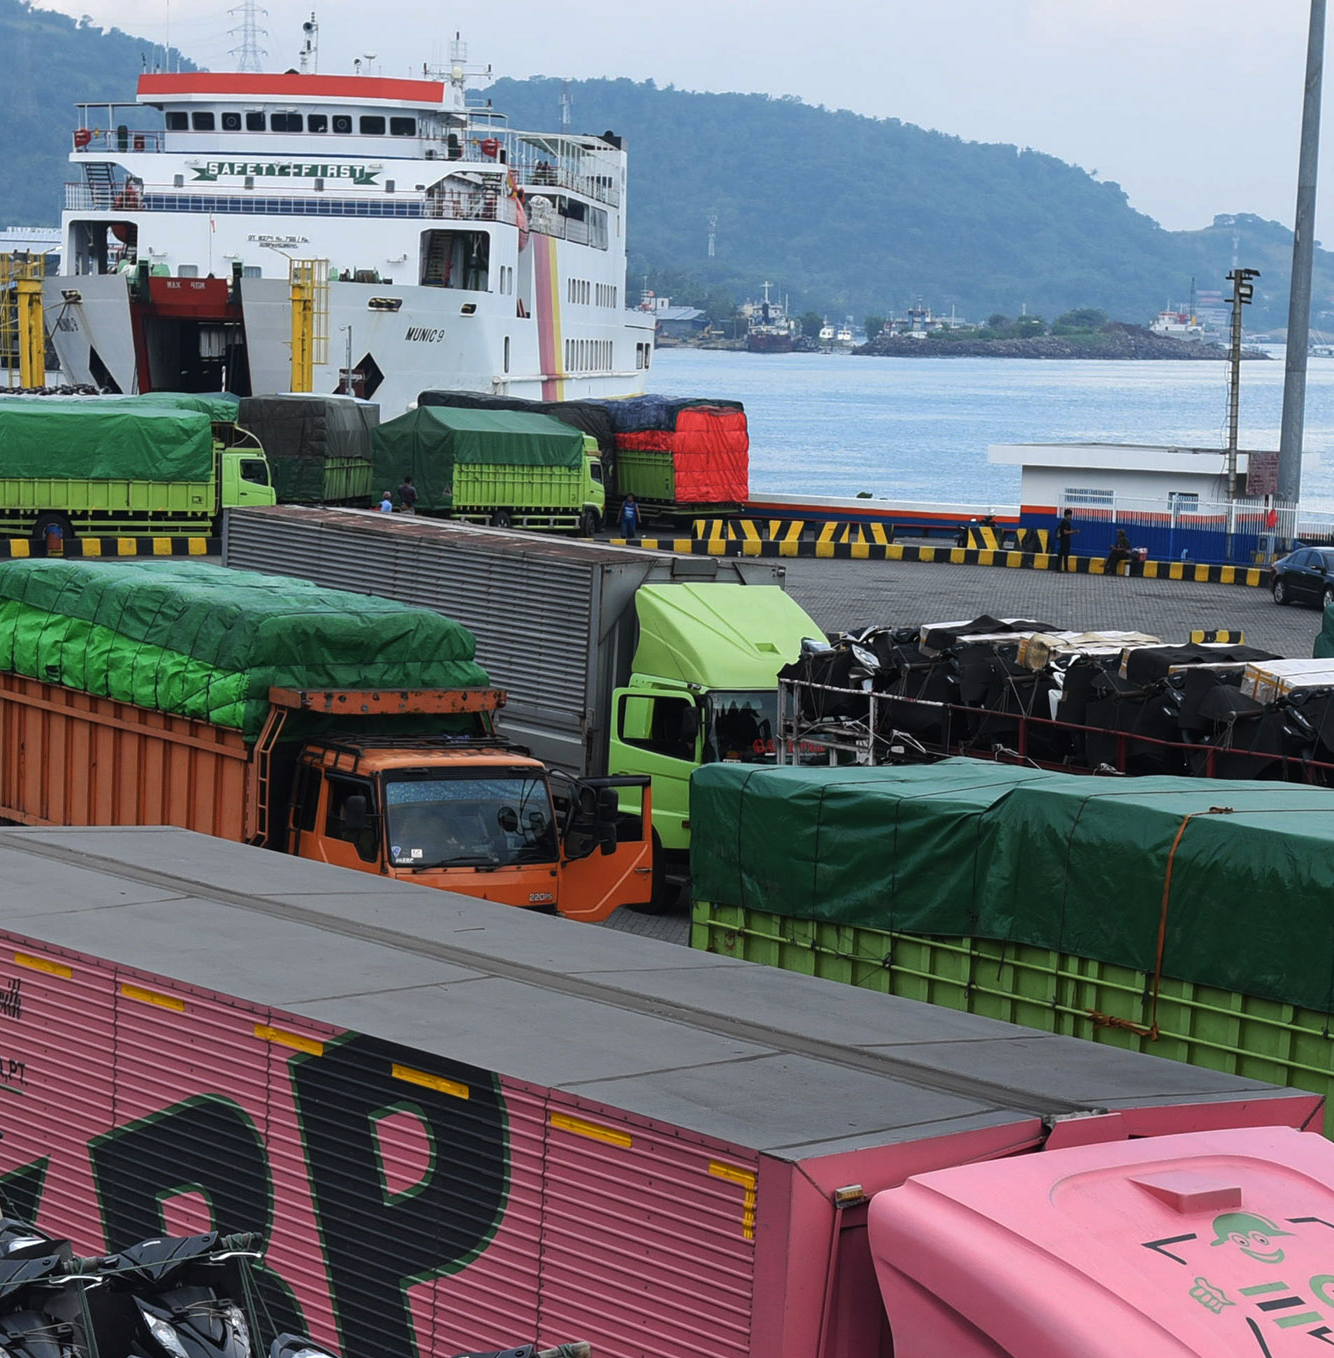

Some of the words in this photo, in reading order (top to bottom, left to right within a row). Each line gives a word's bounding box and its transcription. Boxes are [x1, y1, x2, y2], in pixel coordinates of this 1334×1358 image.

[208, 163, 280, 175] SAFETY
[301, 165, 364, 178] FIRST
[405, 327, 437, 342] MUNIC
[436, 329, 445, 342] 9
